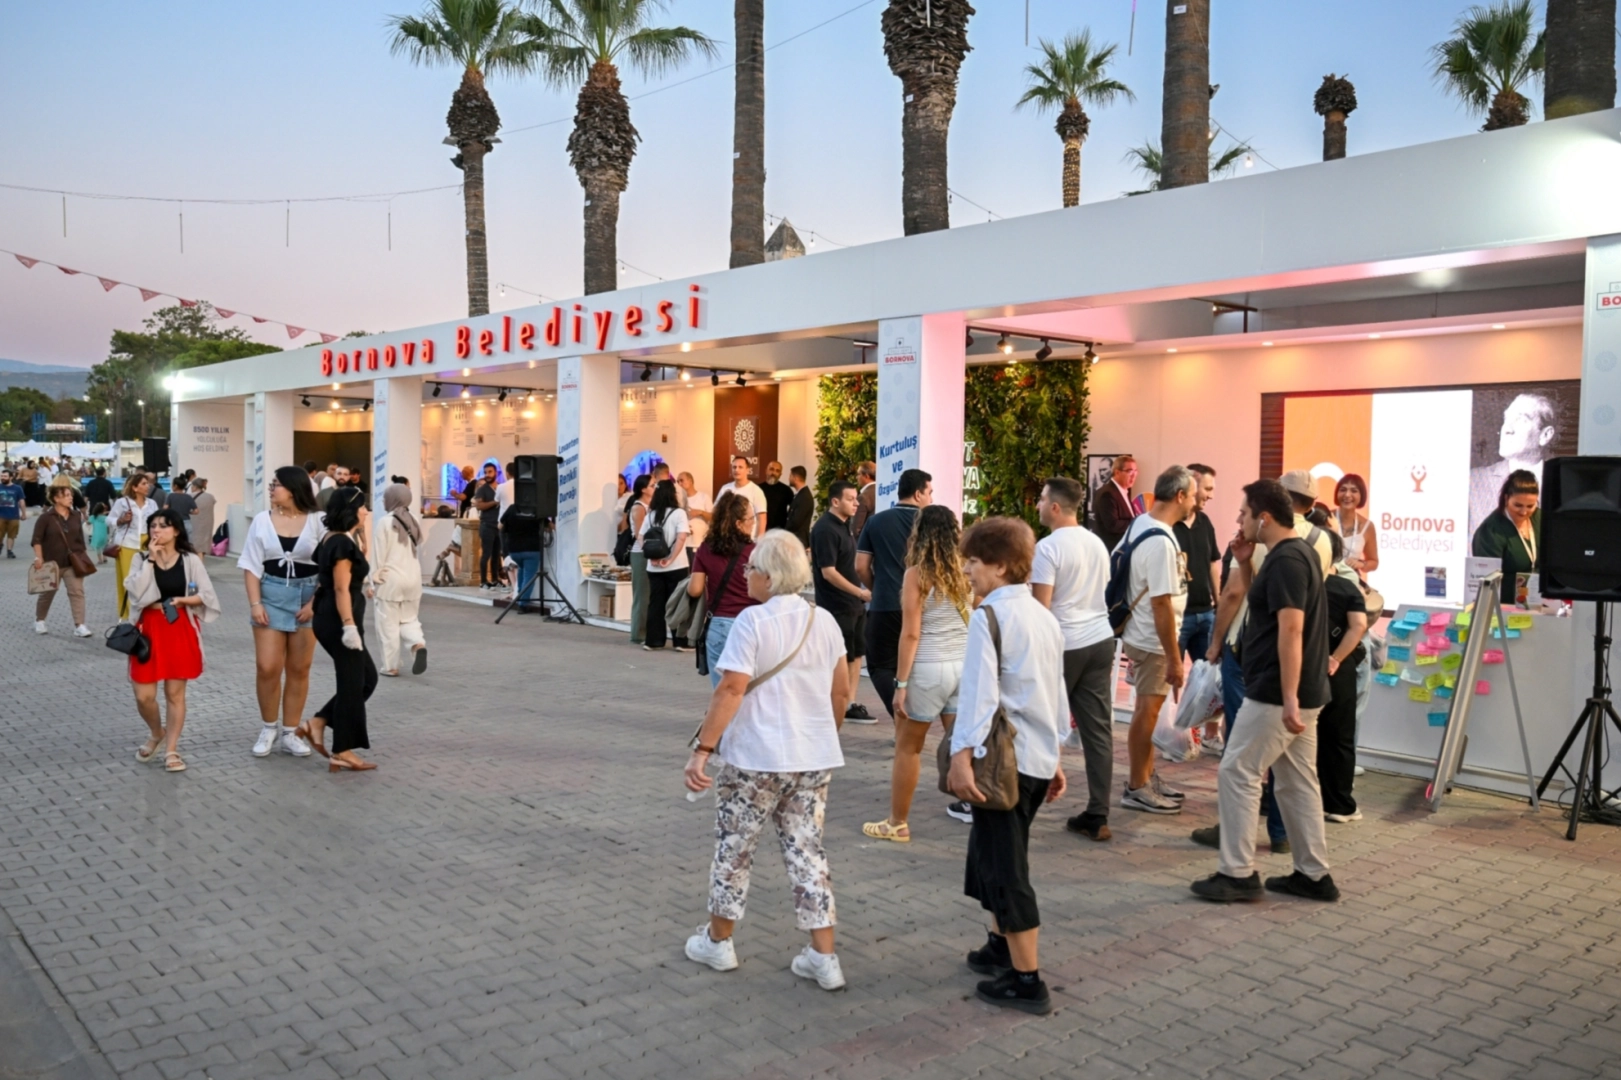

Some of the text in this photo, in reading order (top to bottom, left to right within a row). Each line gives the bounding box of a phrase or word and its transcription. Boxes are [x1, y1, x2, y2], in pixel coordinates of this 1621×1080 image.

[320, 283, 700, 377] Bornova Belediyesi
[885, 355, 915, 363] BORNOVA
[193, 425, 230, 434] 8500 YILLIK
[879, 435, 918, 459] Kurtuluş
[892, 459, 904, 473] ve
[559, 467, 577, 486] Renkli
[878, 481, 899, 496] Özgür
[1381, 512, 1455, 533] Bornova
[1380, 533, 1454, 554] Belediyesi
